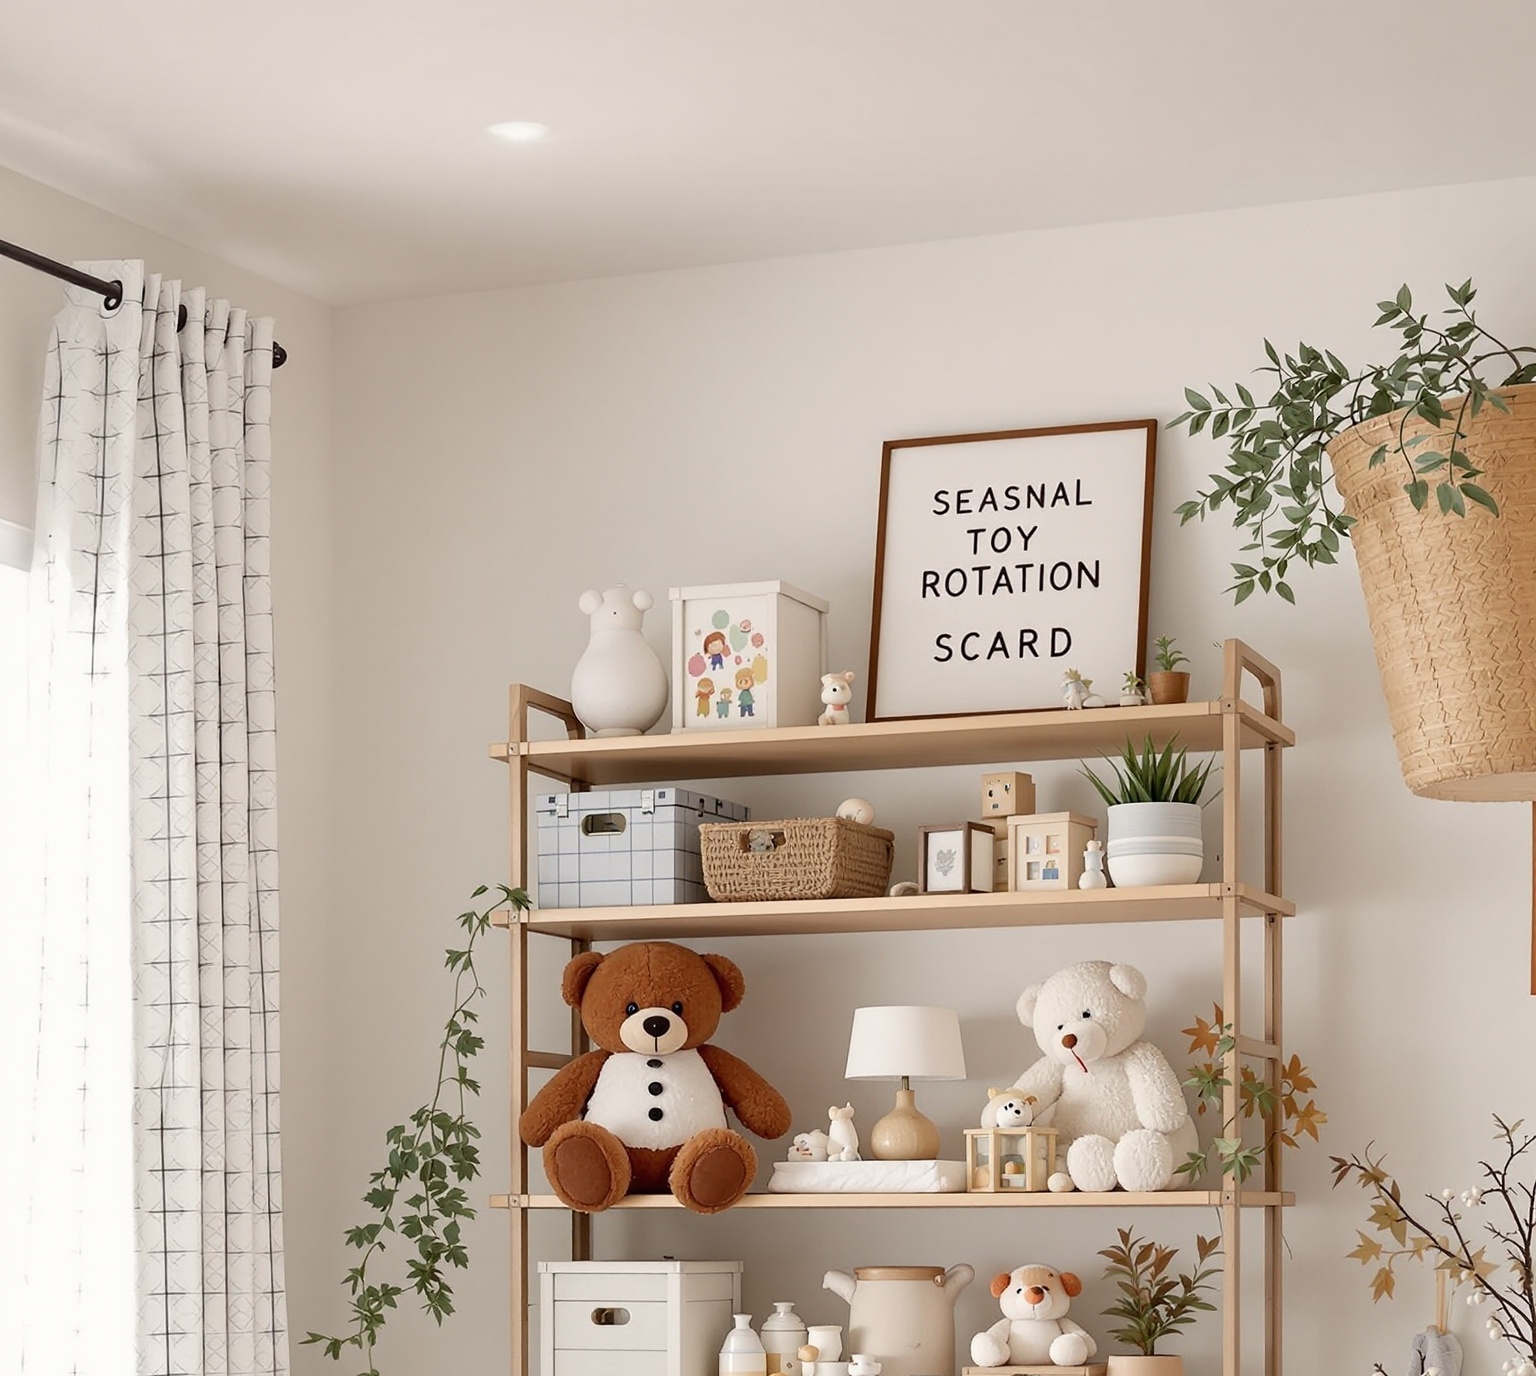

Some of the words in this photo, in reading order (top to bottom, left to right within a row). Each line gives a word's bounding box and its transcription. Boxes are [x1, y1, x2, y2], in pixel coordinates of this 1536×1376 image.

[932, 478, 1093, 516] SEASNAL
[966, 525, 1038, 555] TOY
[921, 559, 1100, 599] ROTATION
[933, 627, 1072, 663] SCARD
